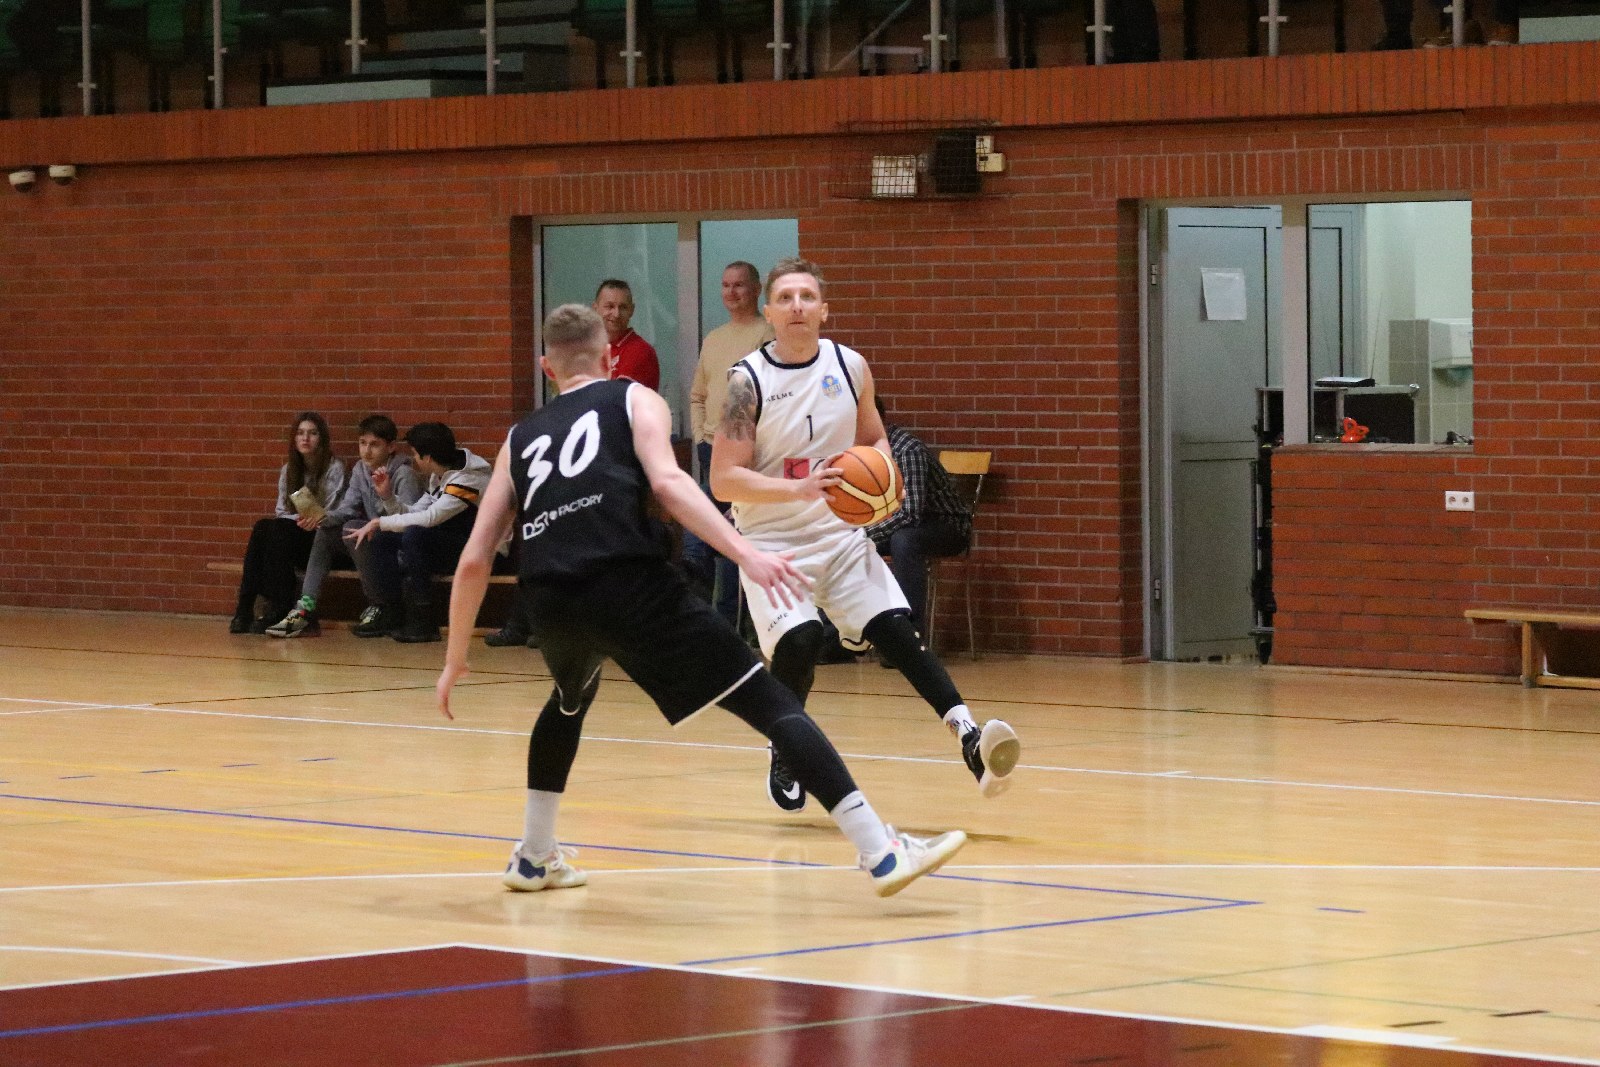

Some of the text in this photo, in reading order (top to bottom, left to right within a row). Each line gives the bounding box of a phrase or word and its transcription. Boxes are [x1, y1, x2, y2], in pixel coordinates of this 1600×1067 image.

[806, 414, 814, 442] 1
[521, 410, 601, 511] 30
[558, 493, 604, 516] FACTORY
